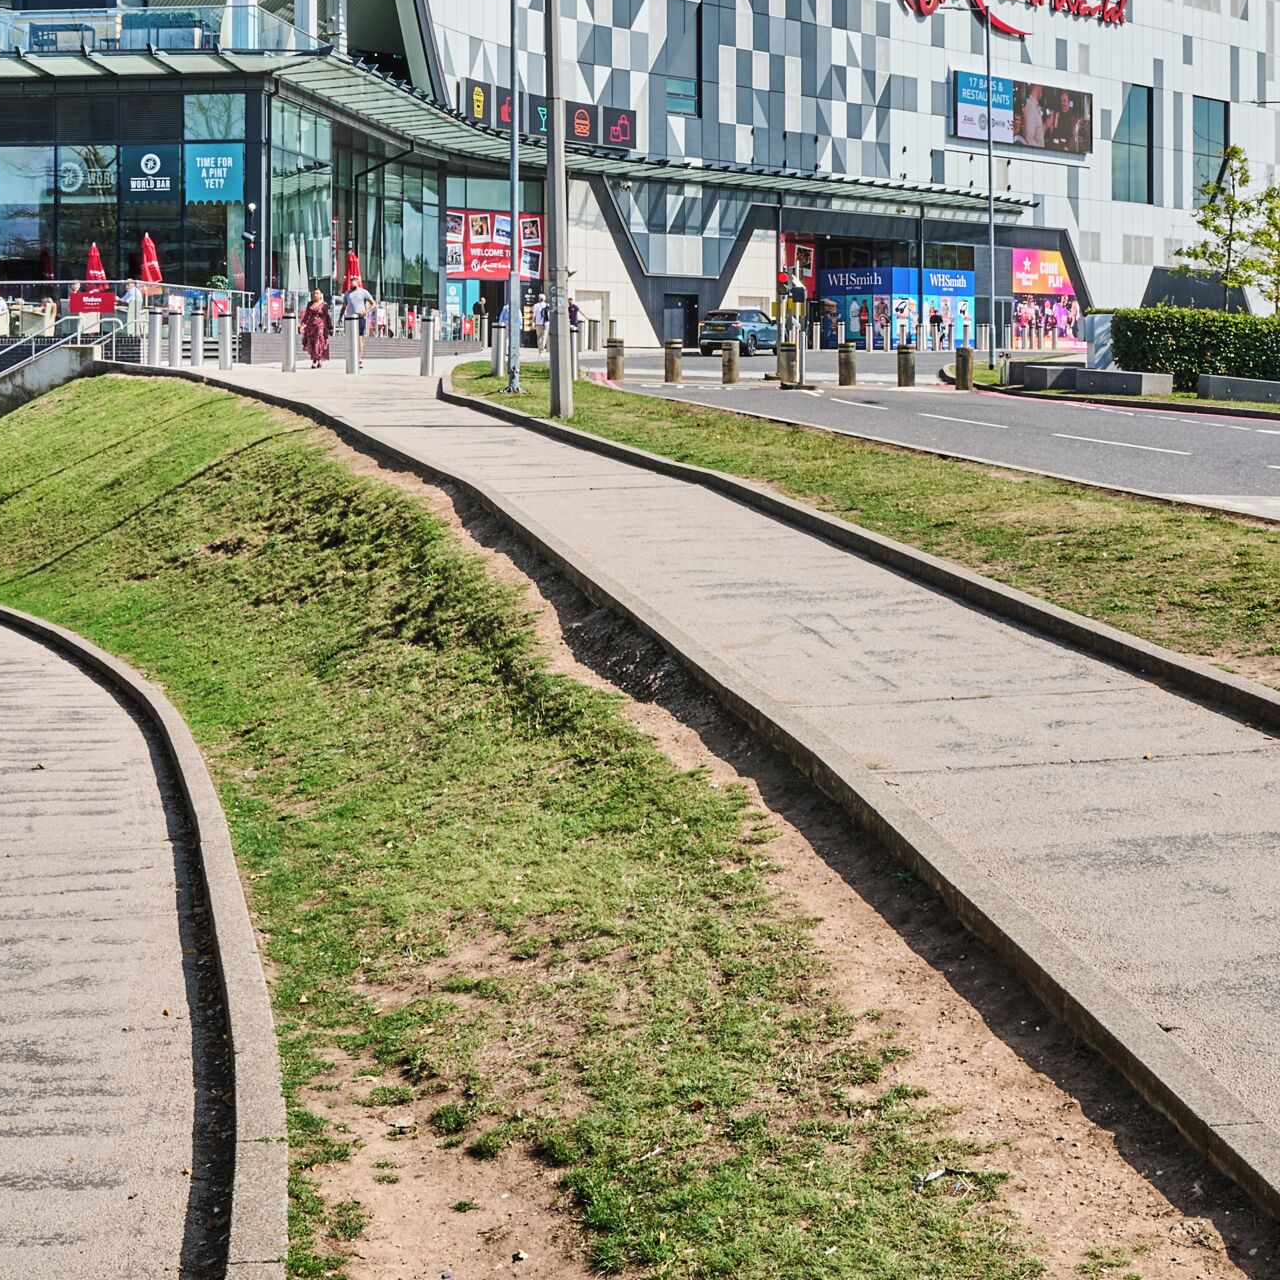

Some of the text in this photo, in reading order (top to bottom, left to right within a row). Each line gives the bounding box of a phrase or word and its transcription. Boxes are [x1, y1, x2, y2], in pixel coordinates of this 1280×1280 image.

[969, 77, 978, 88] 17
[998, 82, 1004, 92] &
[962, 88, 1010, 105] RESTAUANTS
[196, 157, 233, 167] TIME FOR
[201, 167, 227, 178] A PINT
[130, 180, 171, 189] WORLD BAR
[204, 178, 224, 189] YET?
[470, 248, 504, 257] WELCOME
[1039, 262, 1058, 275] COME
[828, 272, 883, 286] WHSmith
[929, 273, 967, 288] WHSmith
[1048, 275, 1064, 288] PLAY
